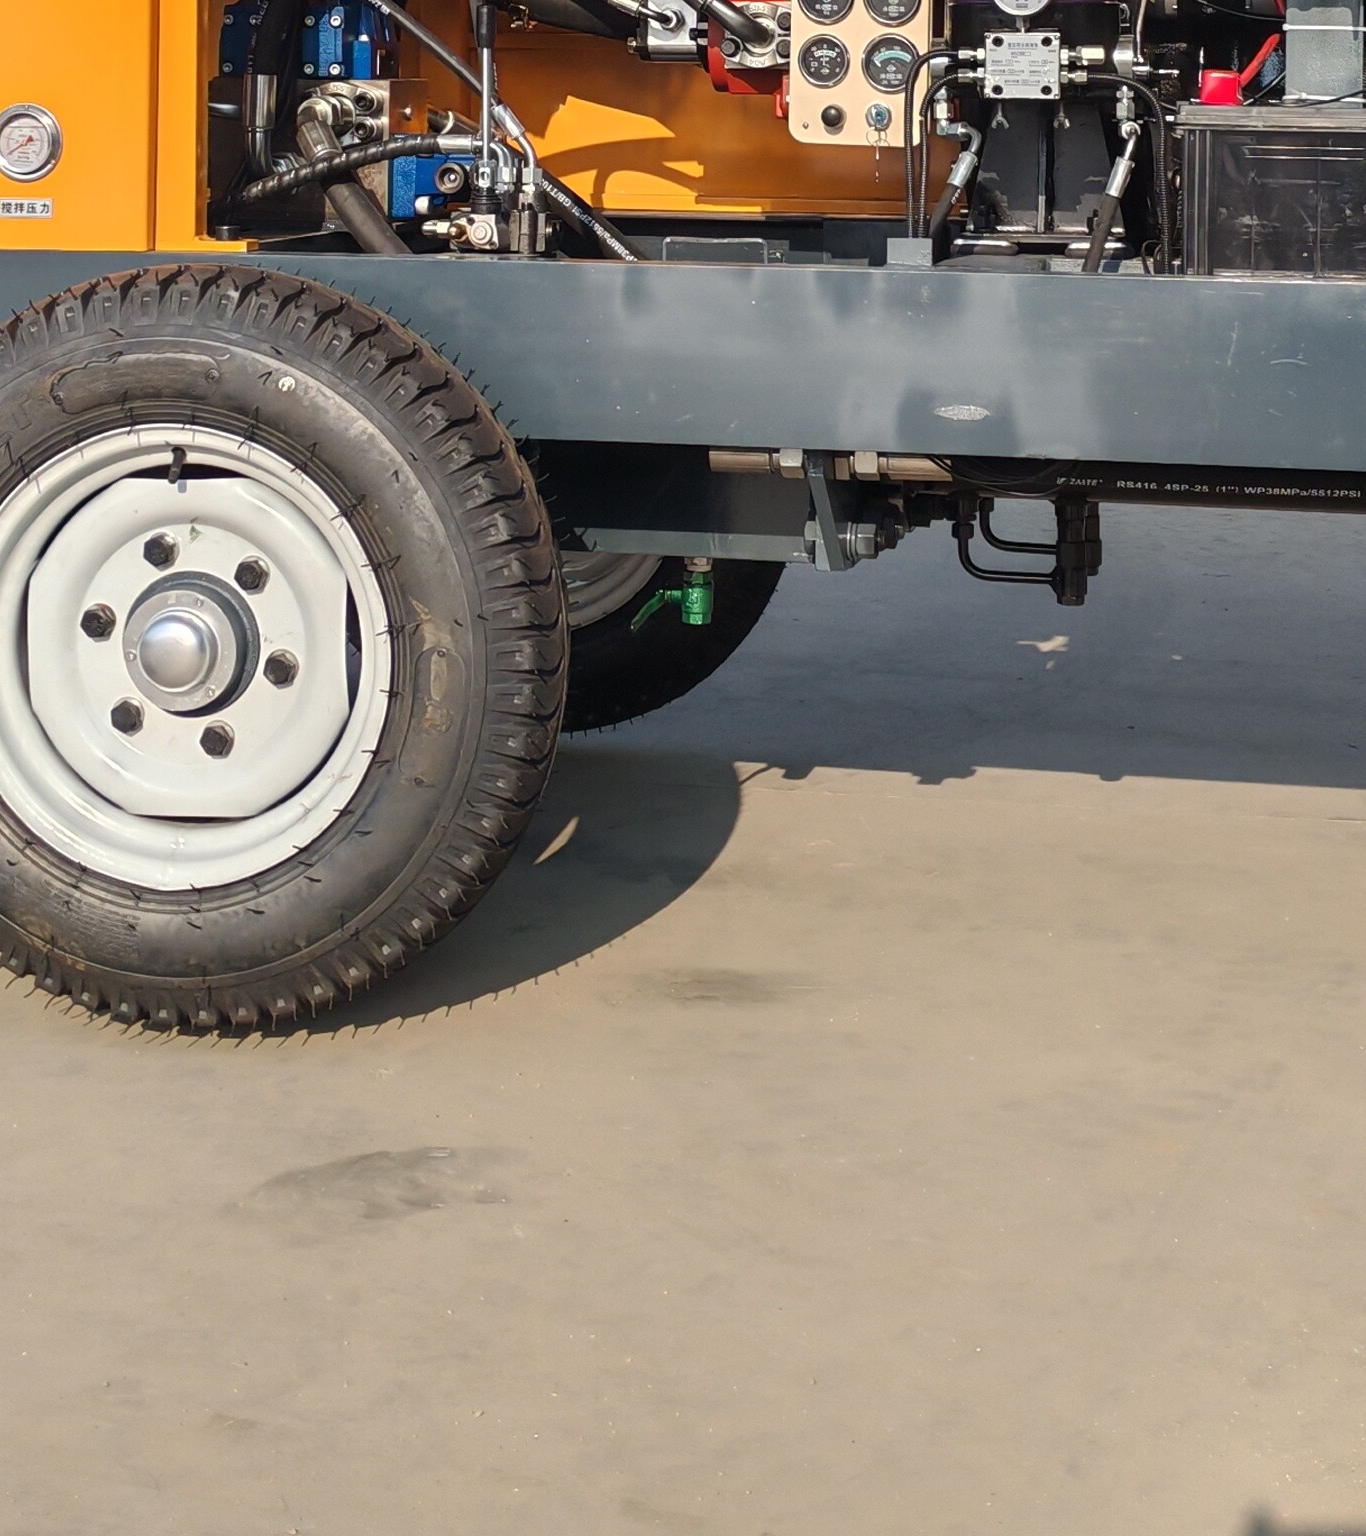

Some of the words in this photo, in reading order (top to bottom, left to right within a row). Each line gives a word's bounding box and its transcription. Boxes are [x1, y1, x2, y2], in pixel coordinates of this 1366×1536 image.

[1, 201, 50, 215] 搅拌压力
[1117, 480, 1158, 490] RS416
[1164, 483, 1209, 493] 4SP-25
[1243, 486, 1361, 498] WP38MPa/5512PSI
